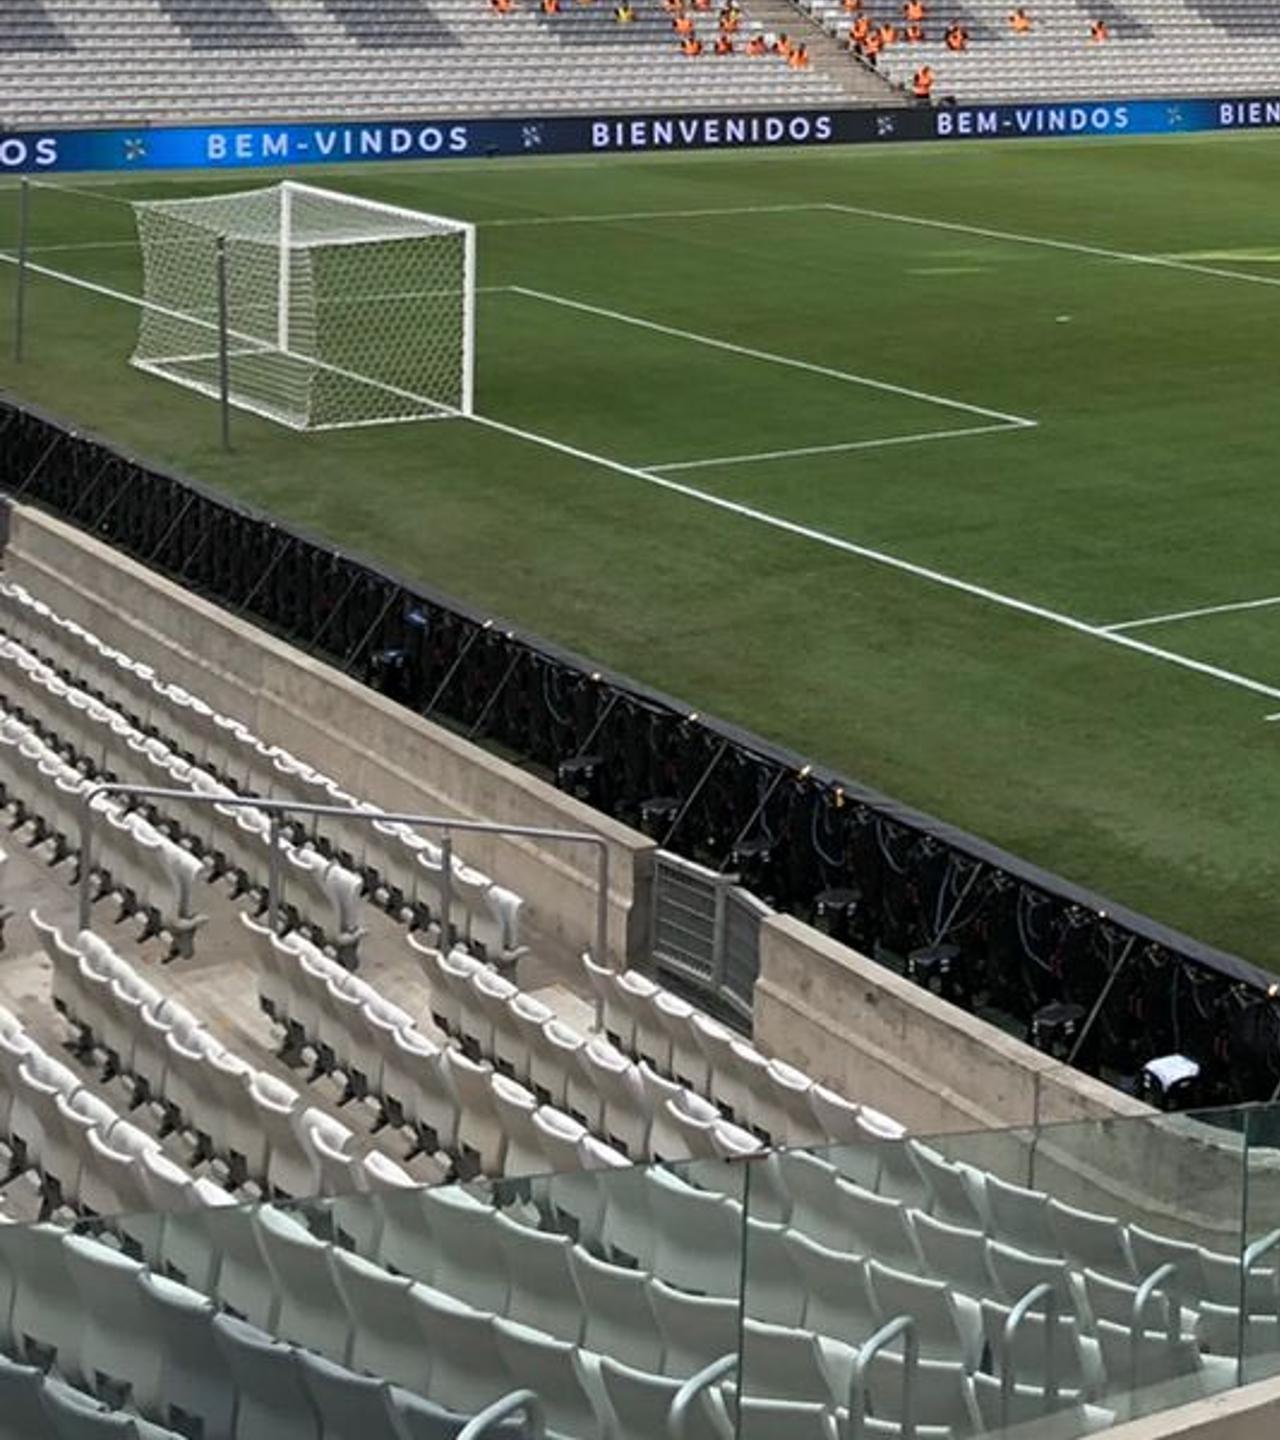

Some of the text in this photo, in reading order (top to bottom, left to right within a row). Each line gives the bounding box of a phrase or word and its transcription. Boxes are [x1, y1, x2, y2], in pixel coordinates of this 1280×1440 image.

[592, 116, 832, 147] BIENVENIDOS
[937, 107, 1129, 135] BEM-VINDOS
[207, 127, 468, 159] BEM-VINDOS
